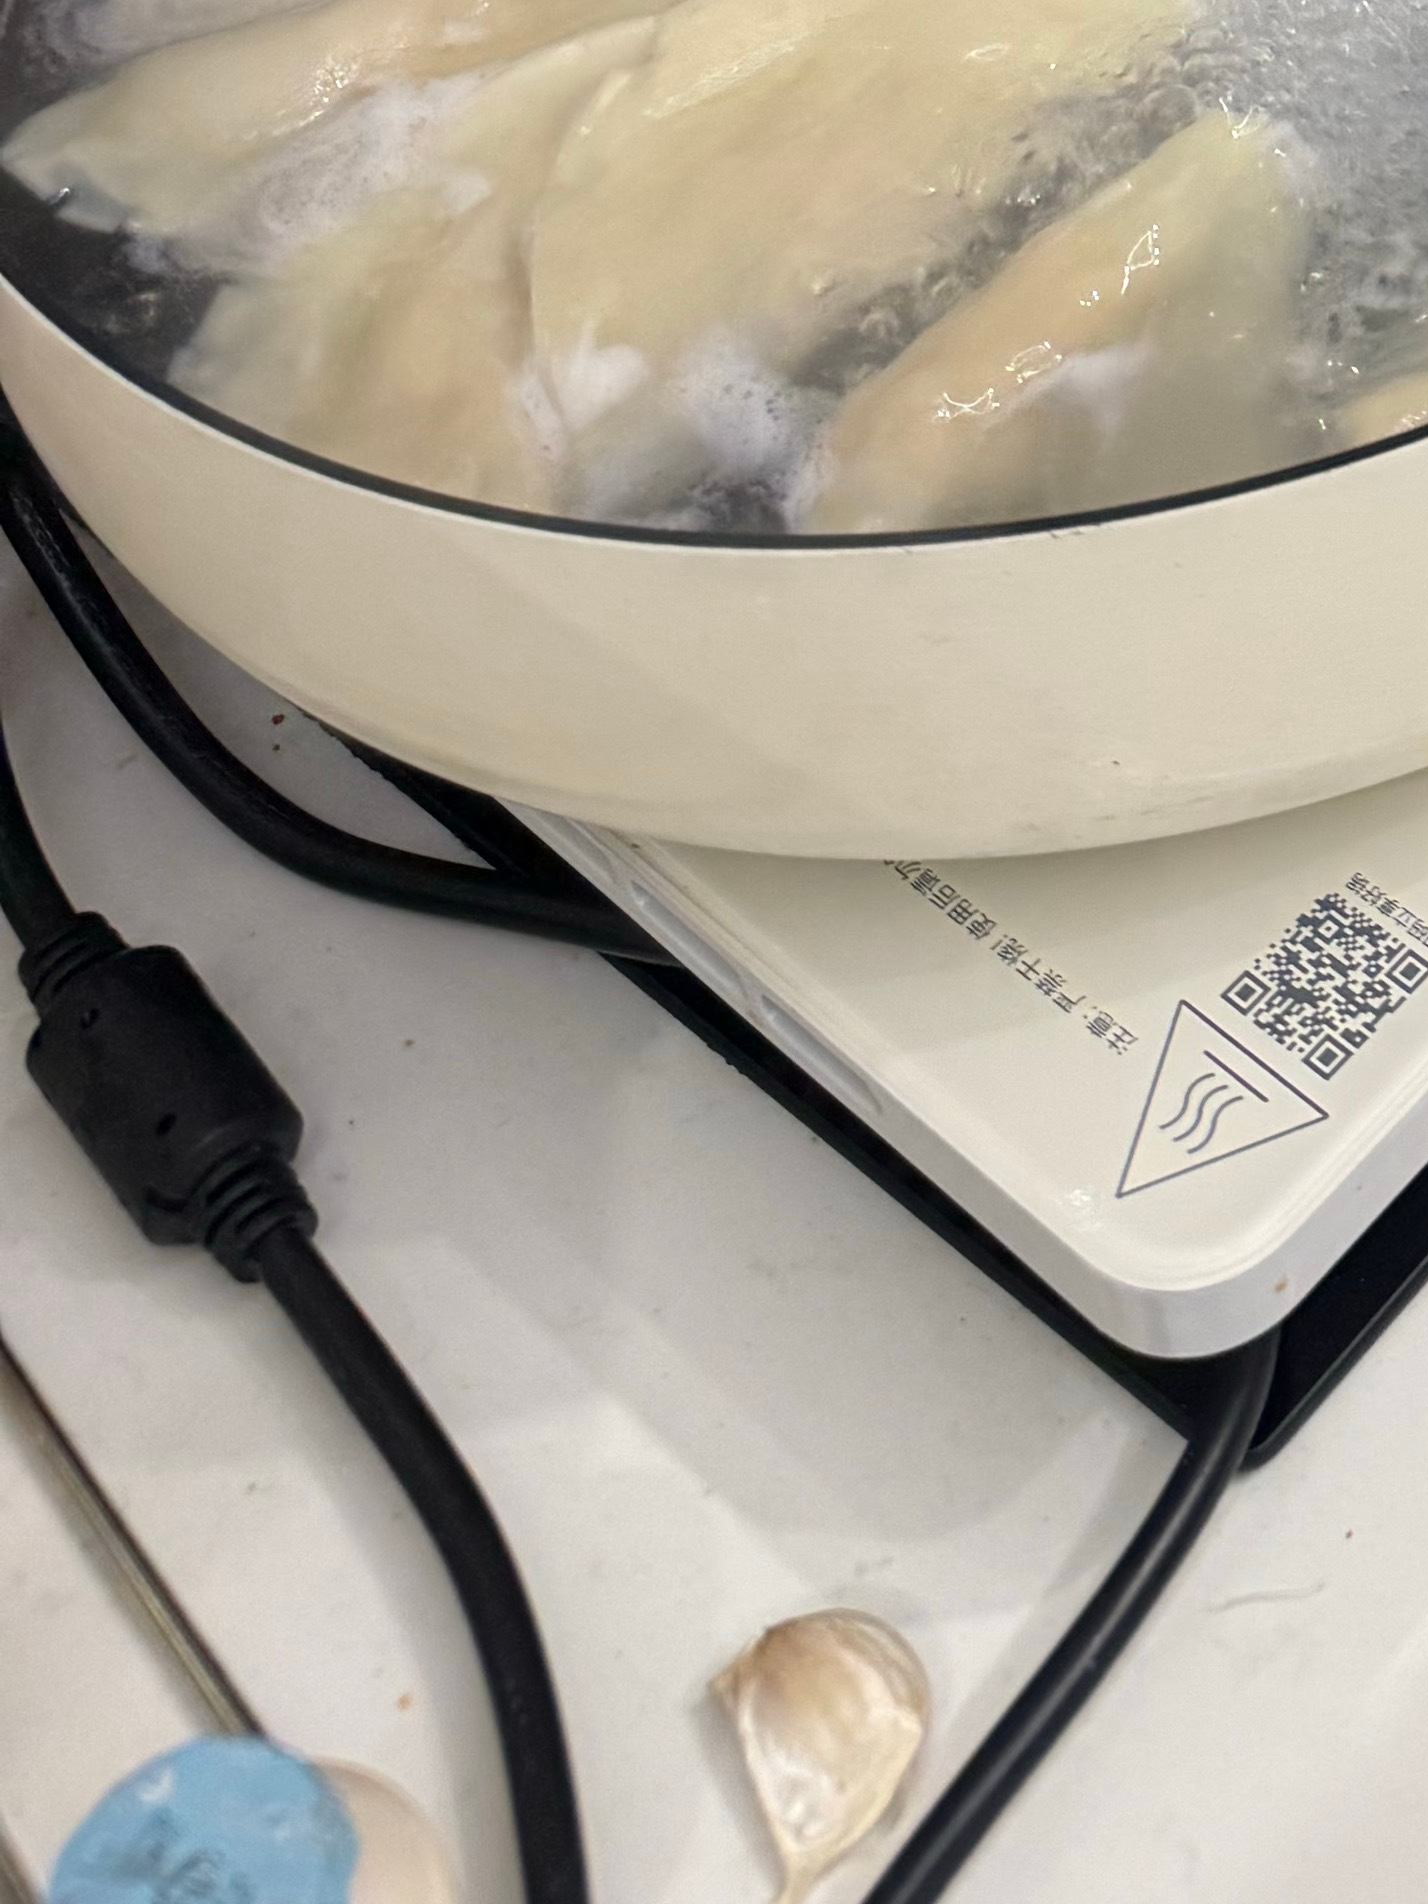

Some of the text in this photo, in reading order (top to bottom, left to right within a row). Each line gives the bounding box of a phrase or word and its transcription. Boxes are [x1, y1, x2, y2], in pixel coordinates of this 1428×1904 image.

[883, 857, 1140, 1055] 注意：严禁干烧！使用后请勿
